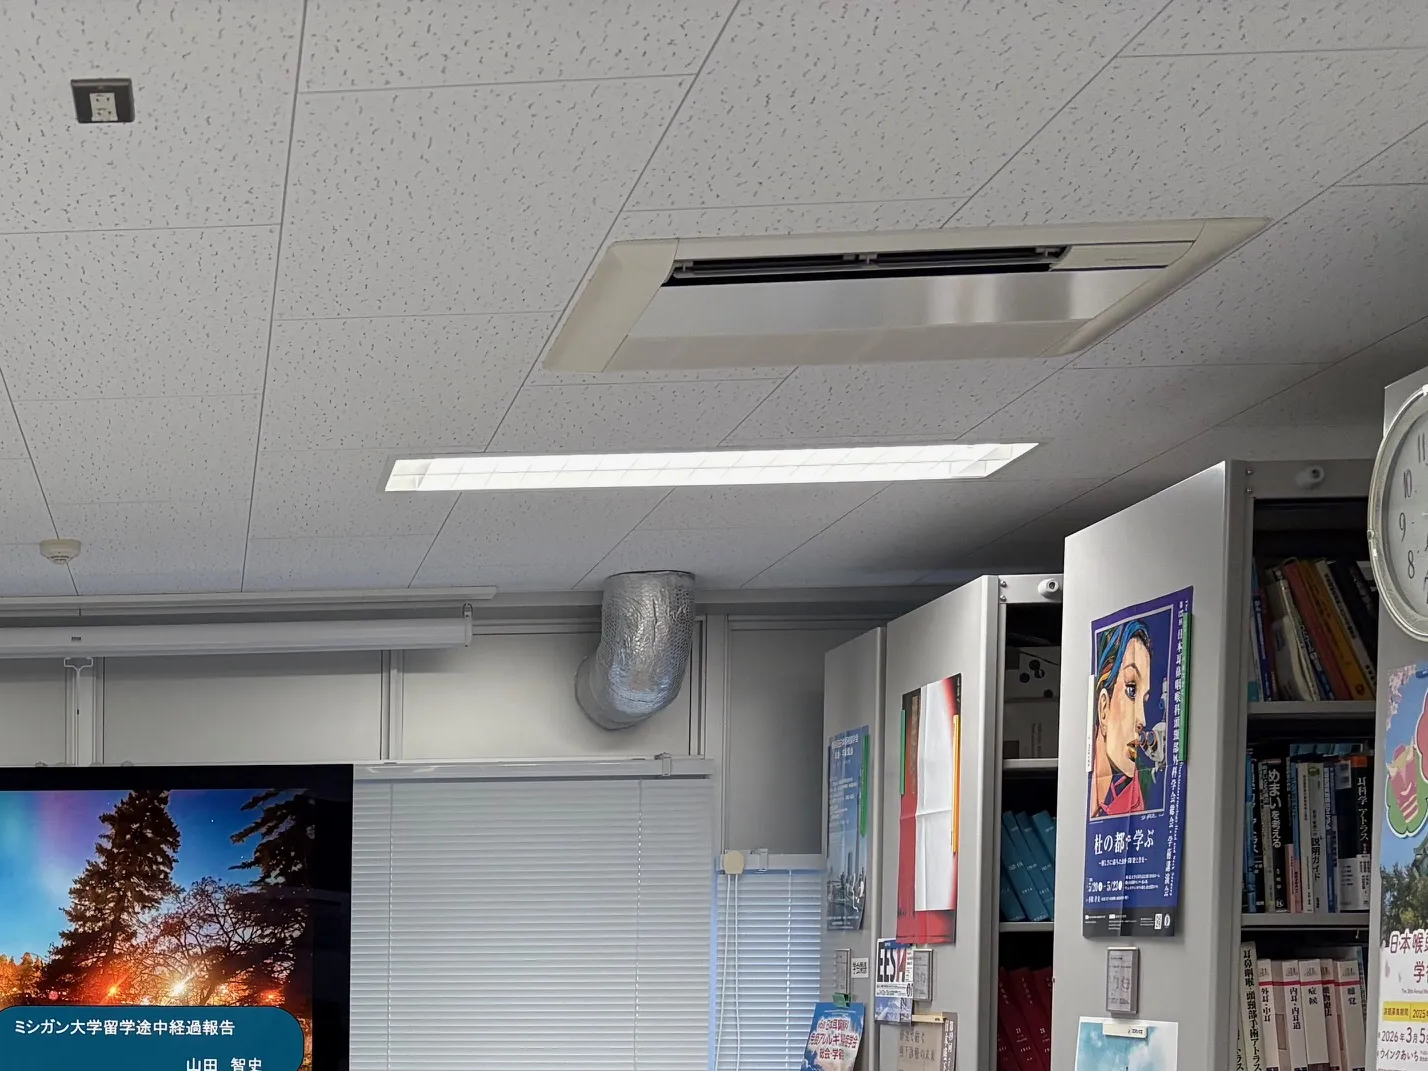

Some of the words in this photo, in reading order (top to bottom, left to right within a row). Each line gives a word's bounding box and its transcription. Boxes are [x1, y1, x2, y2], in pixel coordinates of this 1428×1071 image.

[1403, 469, 1413, 498] 10
[1408, 550, 1415, 579] 8
[15, 1018, 236, 1036] ミシガン大学留学途中経過報告
[1380, 1049, 1419, 1062] ウインクあいち
